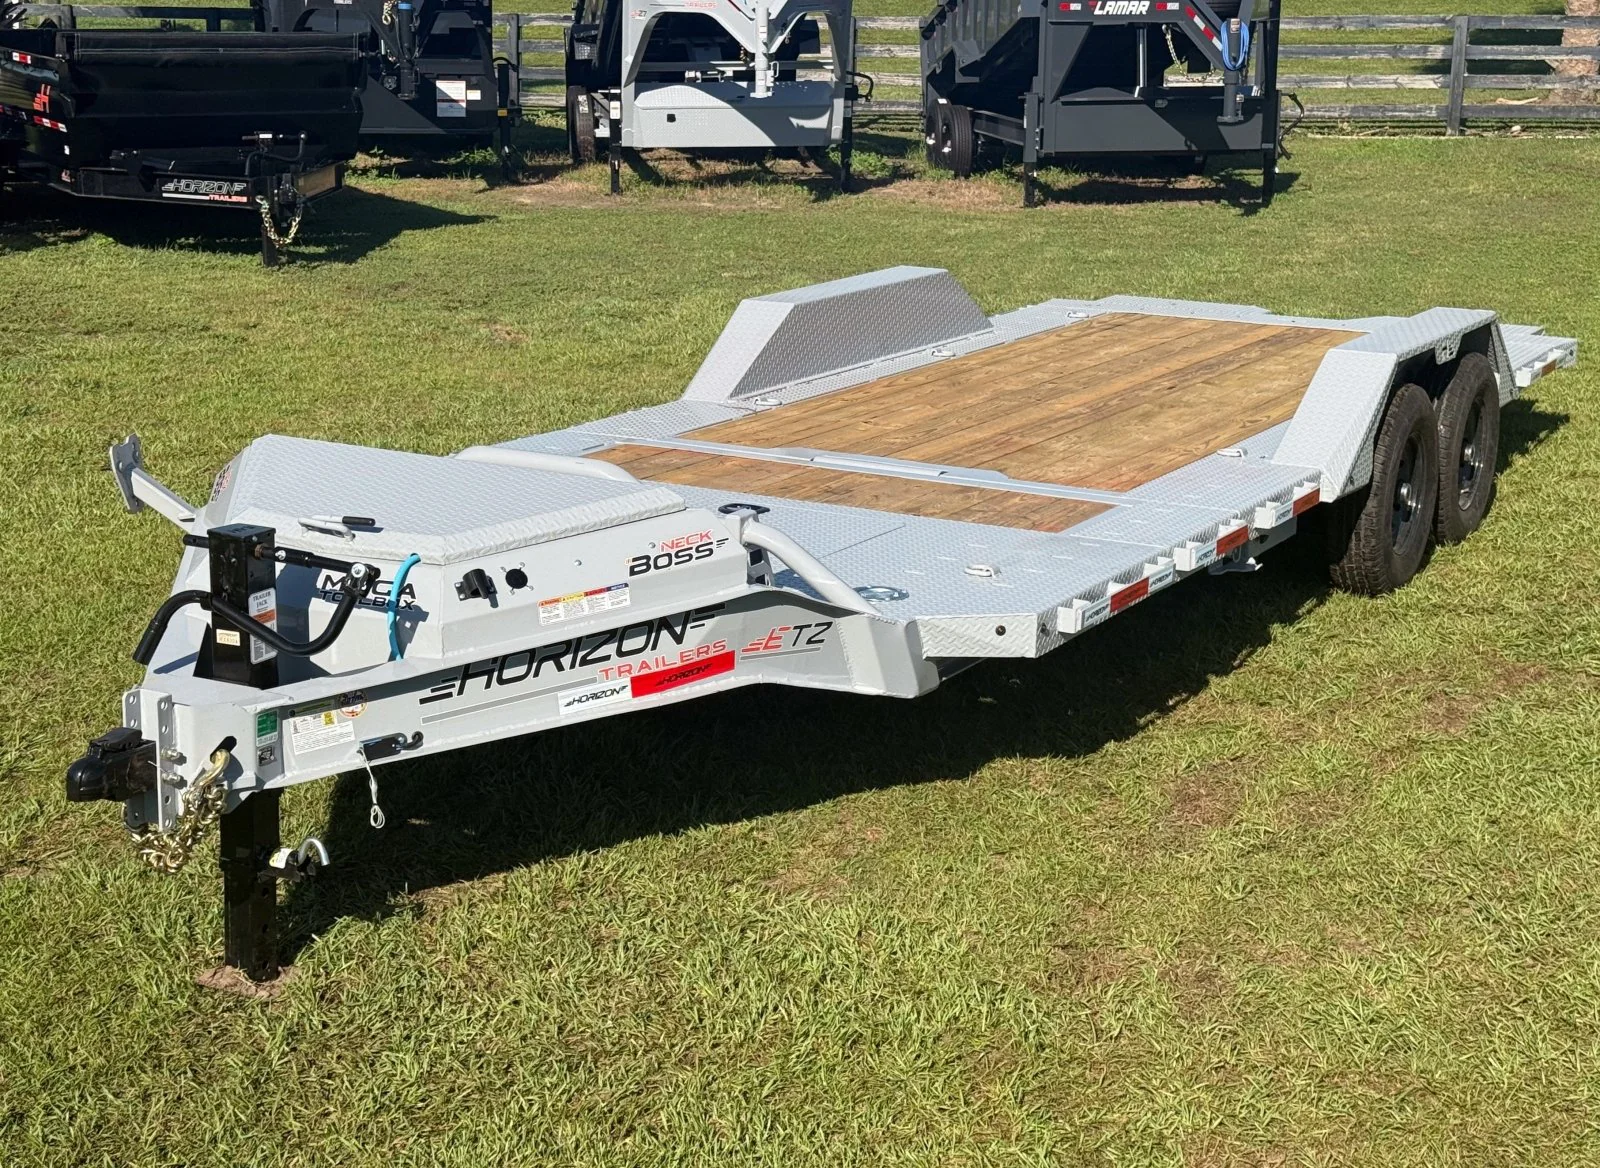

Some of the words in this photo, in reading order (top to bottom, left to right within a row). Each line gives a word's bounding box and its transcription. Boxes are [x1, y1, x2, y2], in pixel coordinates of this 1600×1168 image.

[1094, 1, 1150, 15] LAMAR
[164, 178, 244, 195] HORIZON
[660, 530, 713, 552] NECK
[629, 541, 714, 576] BOSS
[321, 574, 417, 600] MGA
[428, 604, 718, 700] HORIZON
[599, 639, 728, 681] TRAILERS
[655, 663, 712, 687] HORIZON
[564, 685, 628, 708] HORIZON
